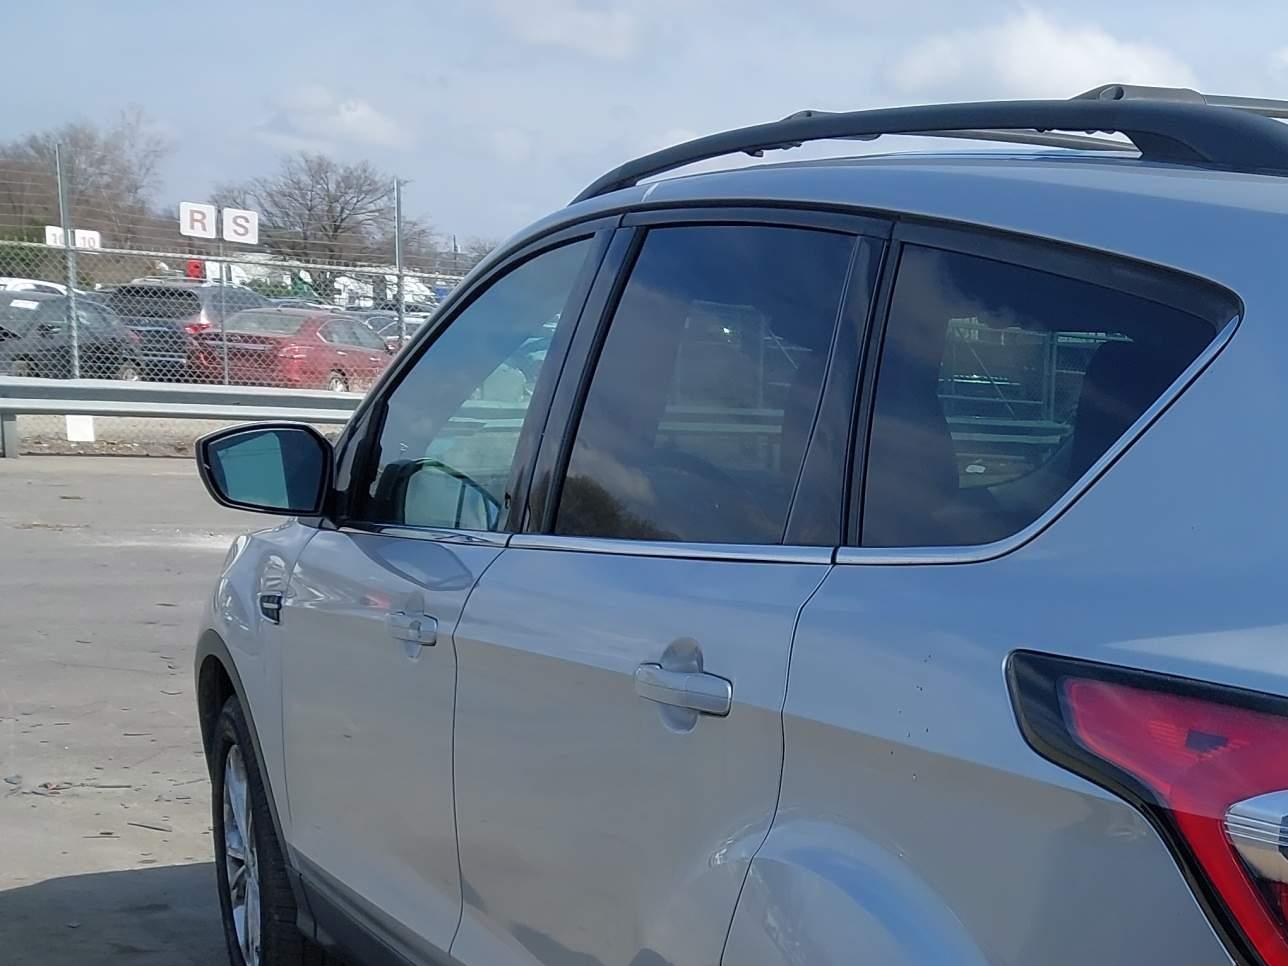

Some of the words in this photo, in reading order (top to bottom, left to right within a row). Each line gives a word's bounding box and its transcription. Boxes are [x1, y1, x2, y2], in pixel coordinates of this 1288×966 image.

[189, 209, 208, 232] R
[232, 215, 250, 237] S
[80, 236, 96, 248] 10
